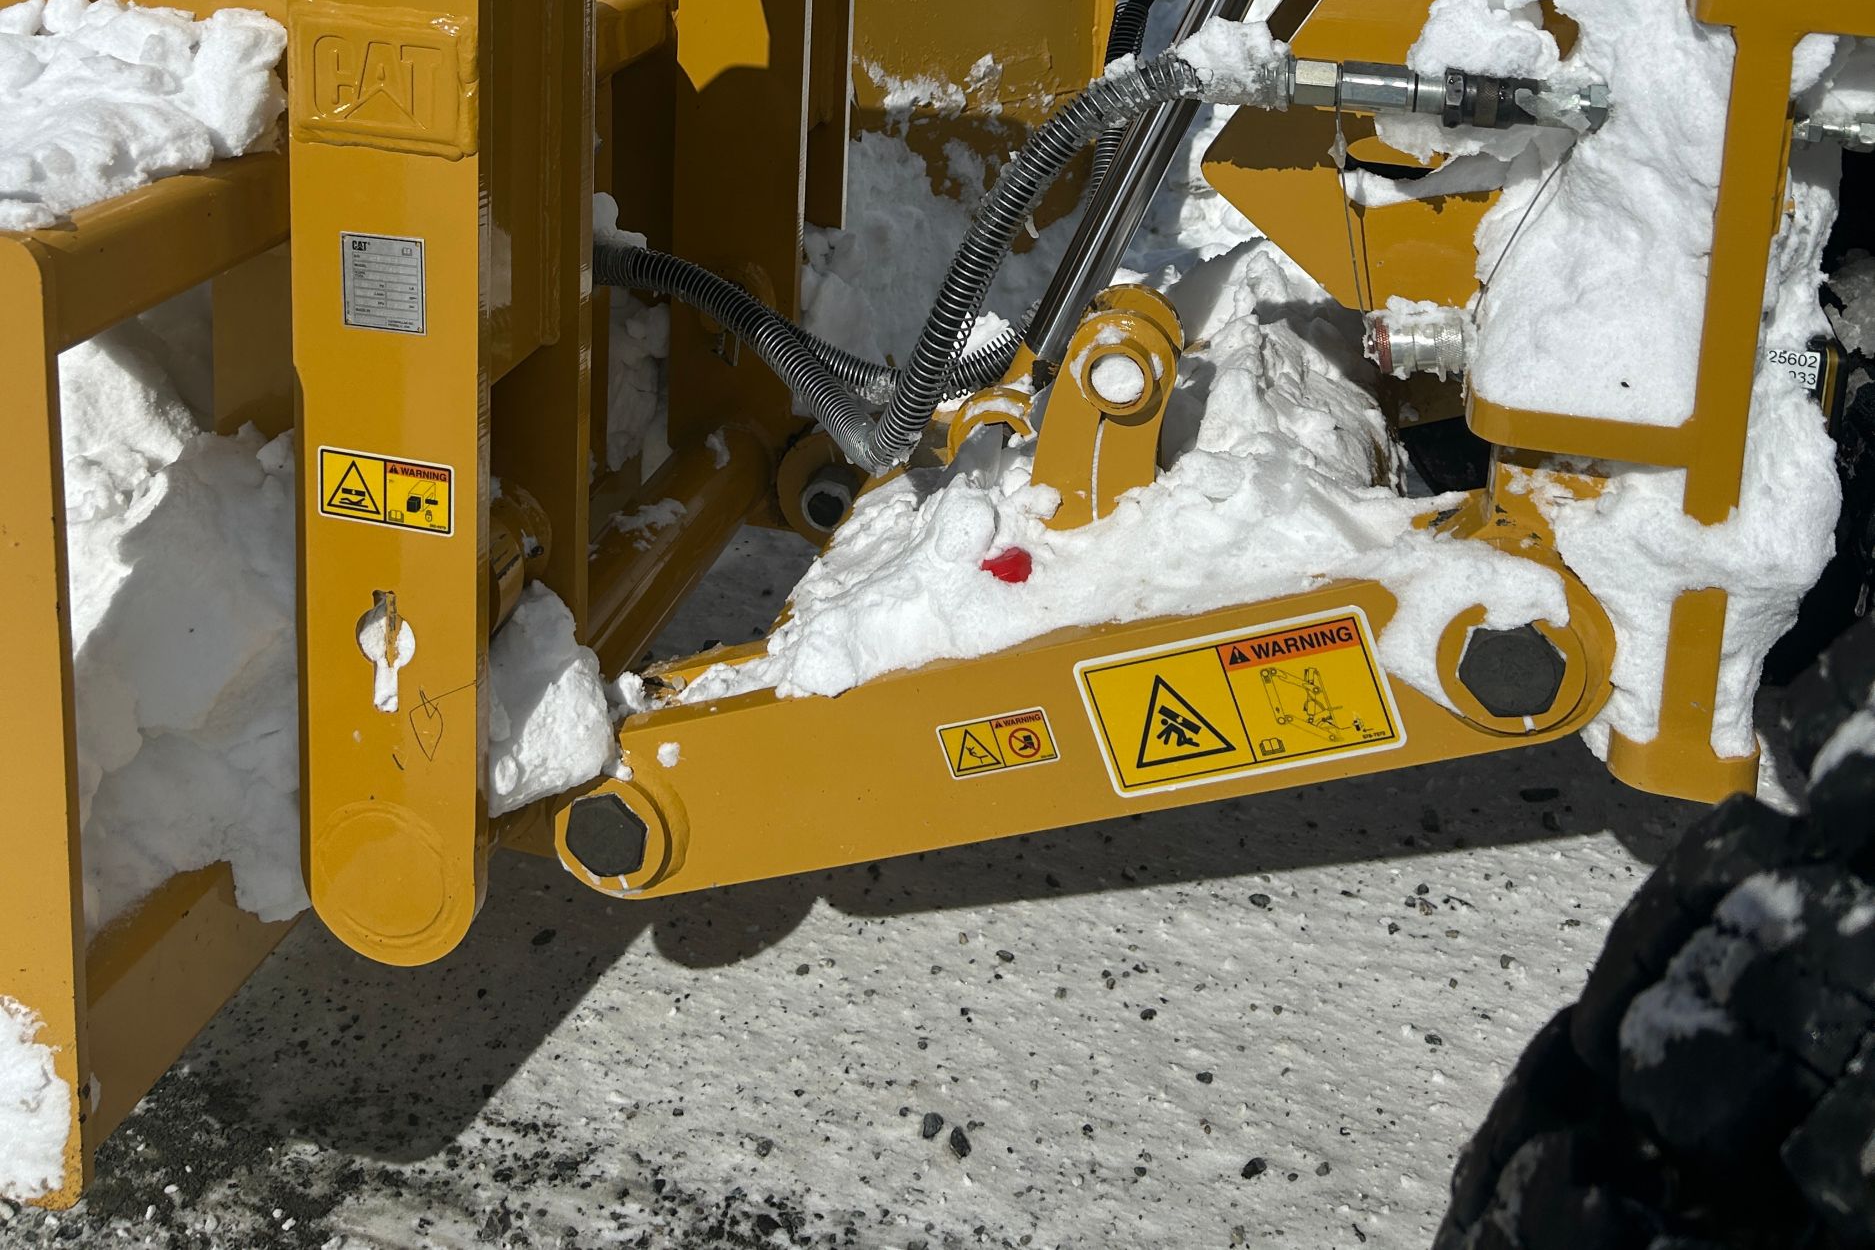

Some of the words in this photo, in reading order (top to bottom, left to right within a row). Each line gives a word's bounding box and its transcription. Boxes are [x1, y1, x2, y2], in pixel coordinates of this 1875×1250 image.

[314, 34, 443, 129] CAT
[352, 240, 368, 251] CAT
[400, 466, 447, 482] WARNING
[1250, 626, 1353, 660] WARNING
[1003, 713, 1041, 727] WARNING
